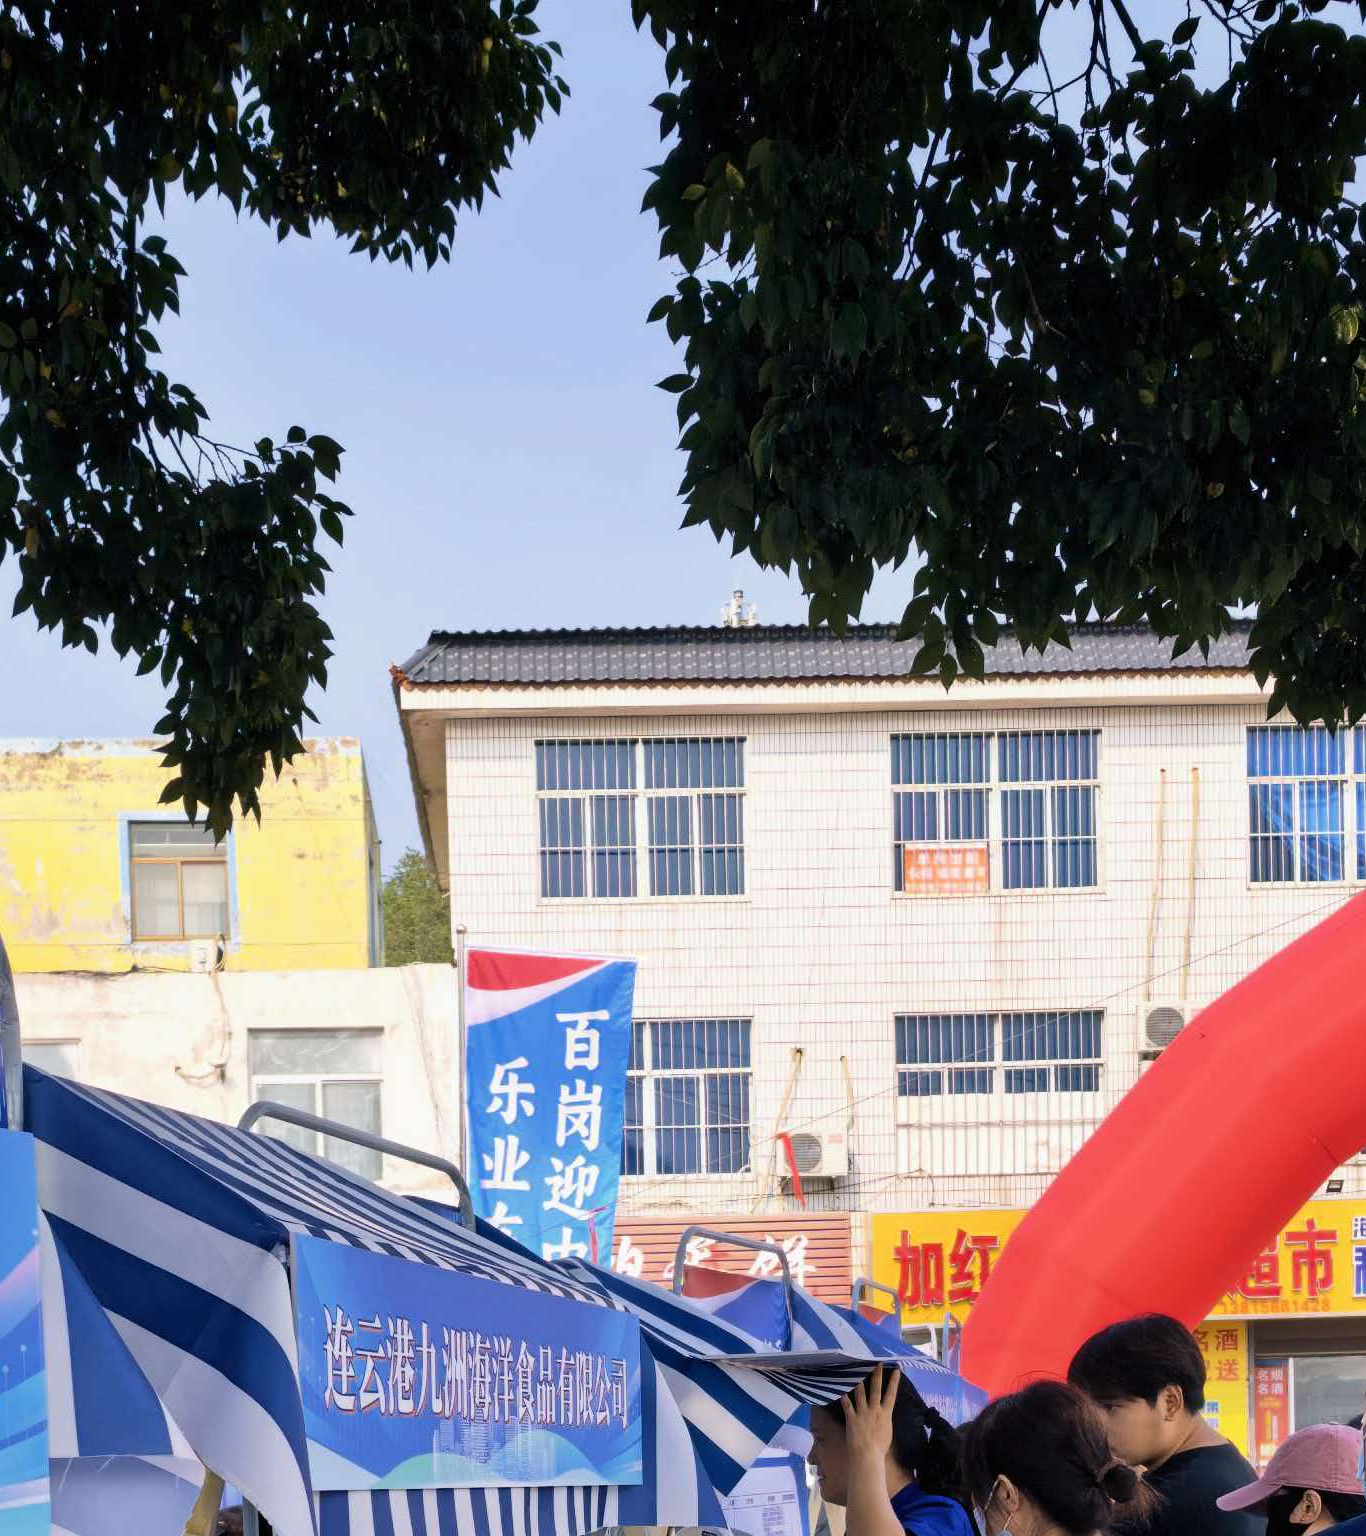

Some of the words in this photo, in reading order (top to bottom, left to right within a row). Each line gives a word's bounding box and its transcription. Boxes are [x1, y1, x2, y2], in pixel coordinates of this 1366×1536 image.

[323, 1303, 629, 1430] 连云港九洲海洋食品有限公司
